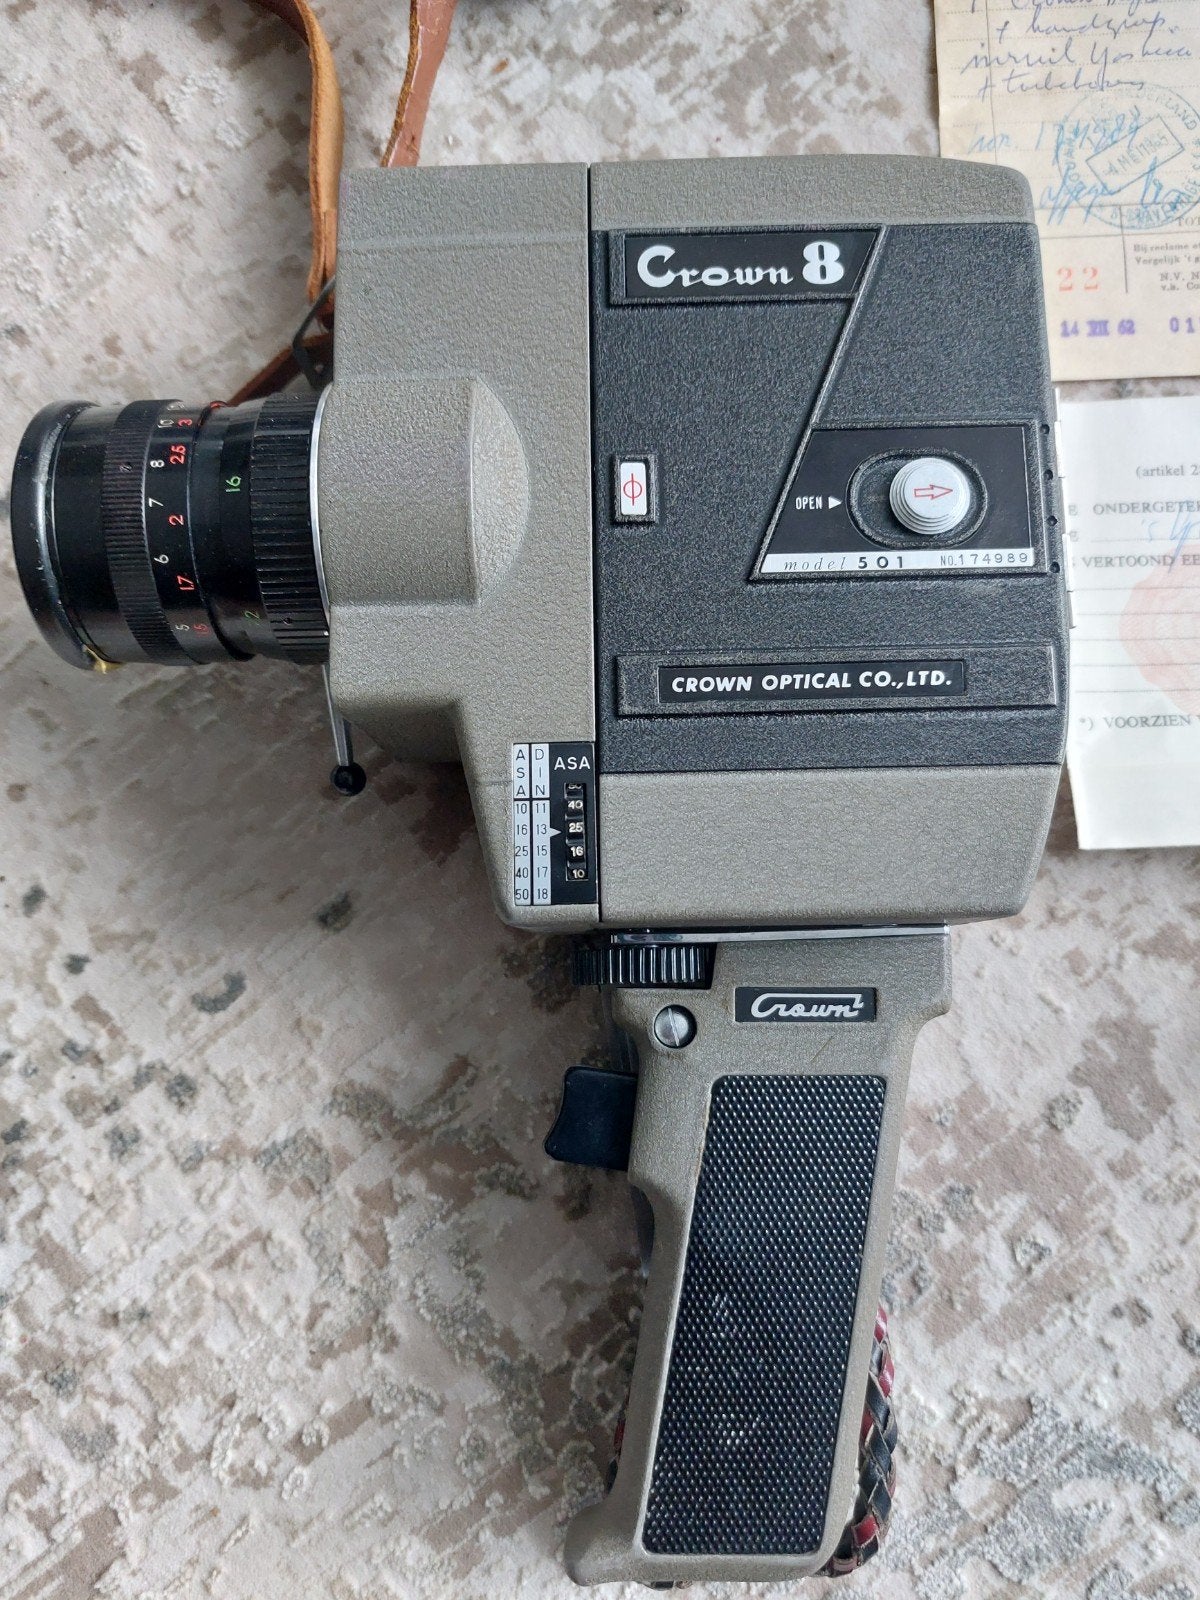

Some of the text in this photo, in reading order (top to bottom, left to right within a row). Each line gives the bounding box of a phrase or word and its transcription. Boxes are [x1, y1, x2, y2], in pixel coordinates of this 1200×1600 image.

[1150, 243, 1189, 252] reclame
[637, 241, 845, 288] Crown 8
[1160, 272, 1186, 282] N.V.
[150, 458, 165, 468] 8
[225, 475, 242, 493] 16
[148, 498, 164, 508] 7
[795, 496, 823, 510] OPEN
[169, 514, 185, 527] 2
[154, 553, 170, 564] 6
[784, 552, 847, 572] model
[858, 556, 904, 570] 501
[1081, 554, 1176, 568] VERTOOND
[671, 676, 752, 693] CROWN
[761, 672, 852, 691] OPTICAL
[1102, 714, 1192, 729] VOORZIEN
[554, 756, 591, 771] ASA
[516, 802, 547, 815] 10 11
[568, 800, 583, 810] 40
[516, 822, 584, 836] 16 13 25
[515, 845, 584, 857] 25 15 16
[515, 867, 585, 879] 40 17 10
[515, 888, 548, 900] 50 18
